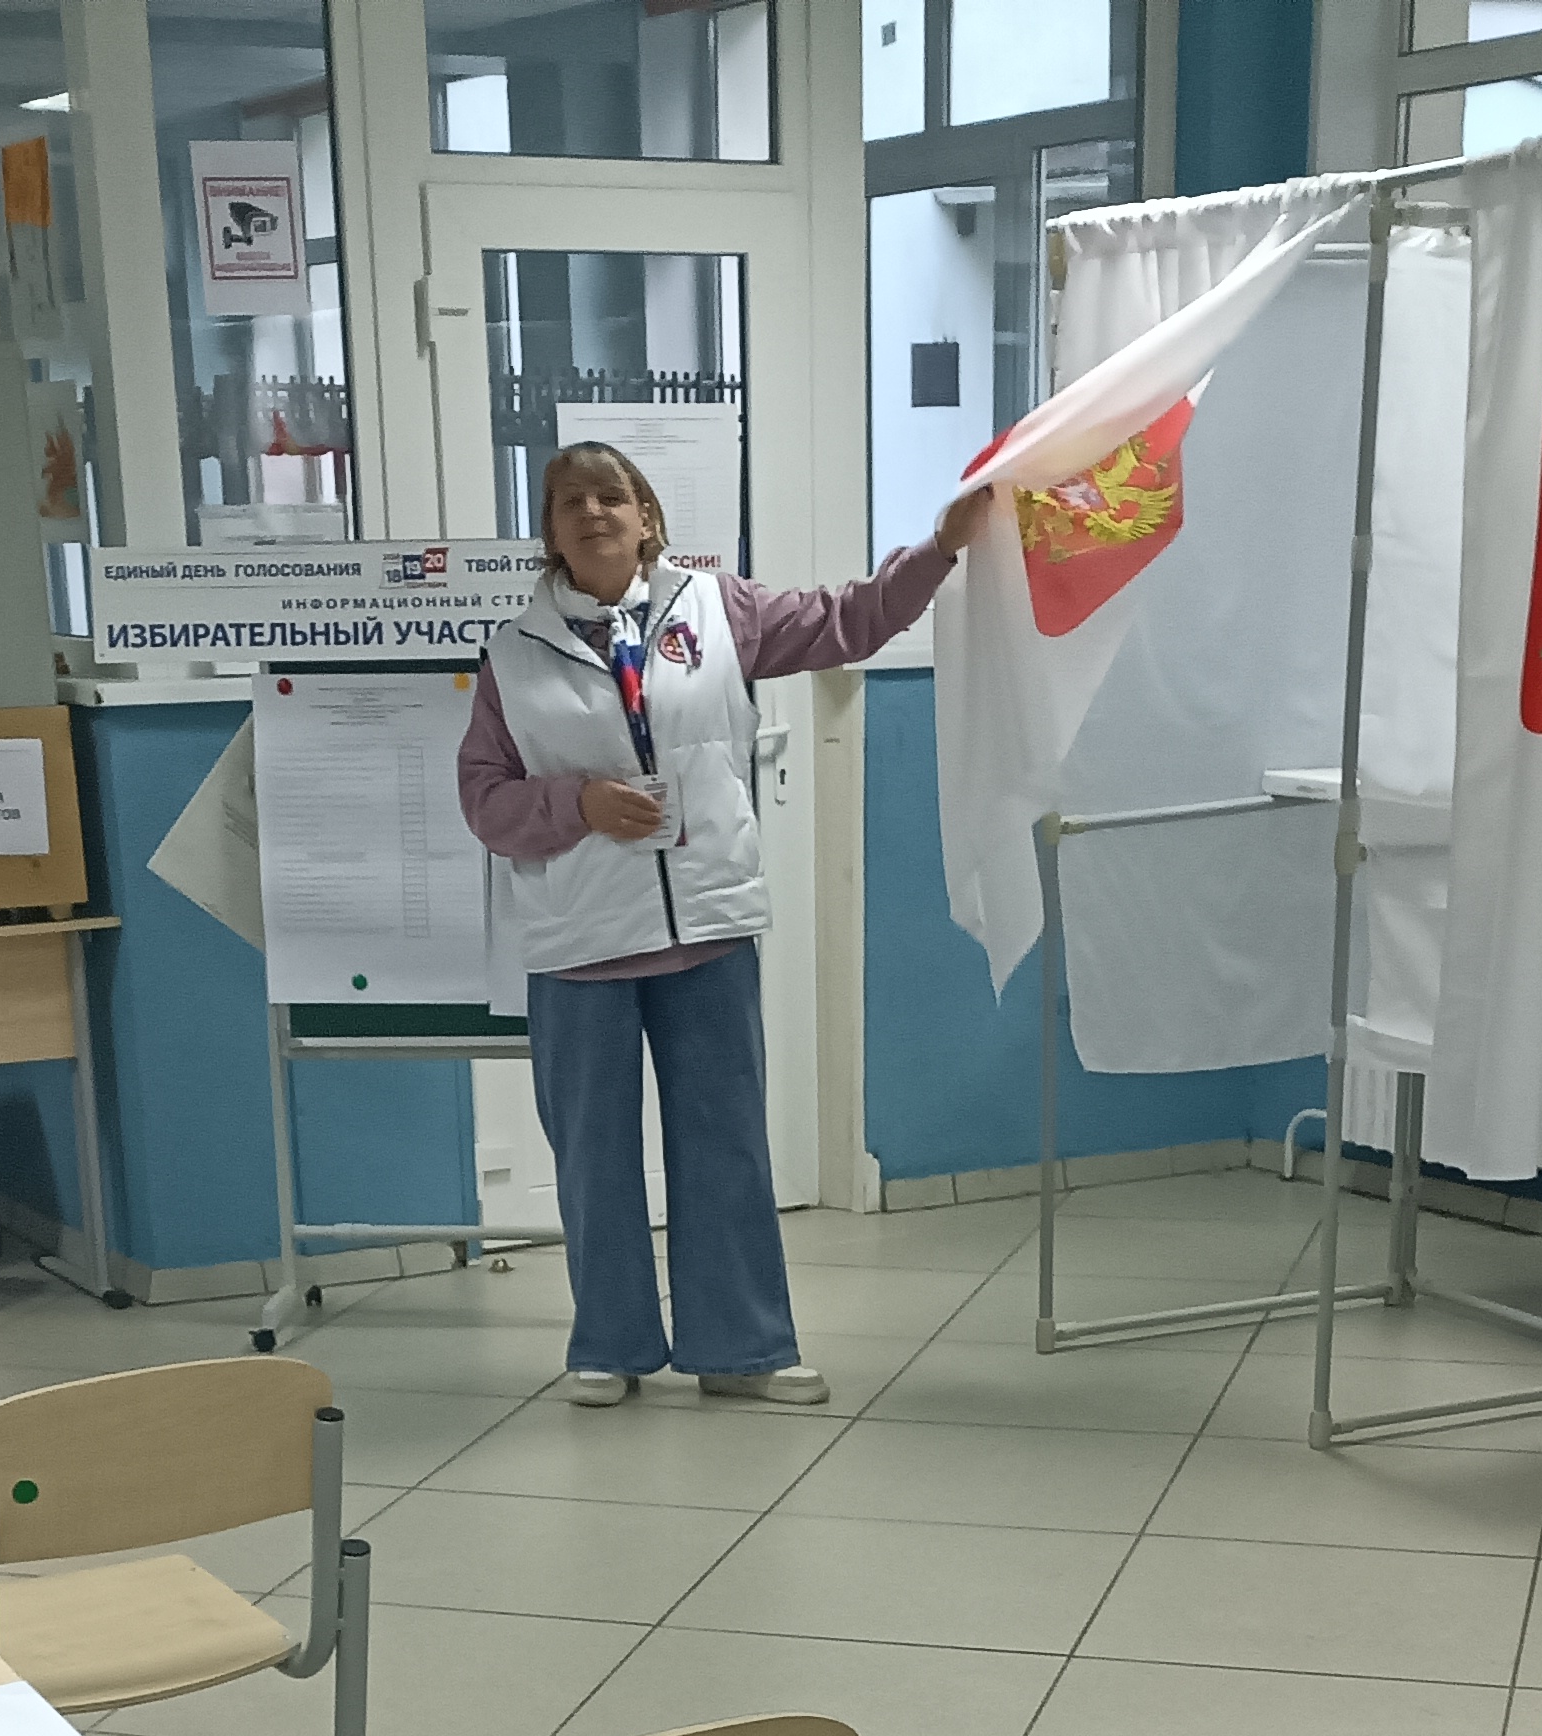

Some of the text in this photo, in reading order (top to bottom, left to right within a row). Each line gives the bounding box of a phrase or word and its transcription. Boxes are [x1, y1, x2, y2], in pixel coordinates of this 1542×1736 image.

[424, 553, 444, 568] 20
[464, 555, 512, 573] ТВОЙ
[668, 555, 721, 569] ССИИ!
[104, 561, 361, 580] ЕДИНЫЙ ДЕНЬ ГОЛОСОВАНИЯ
[281, 593, 534, 611] ИНФОРМАЦИОННЫЙ СТЕ
[107, 615, 514, 648] ИЗБИРАТЕЛЬНЫЙ УЧАСТ
